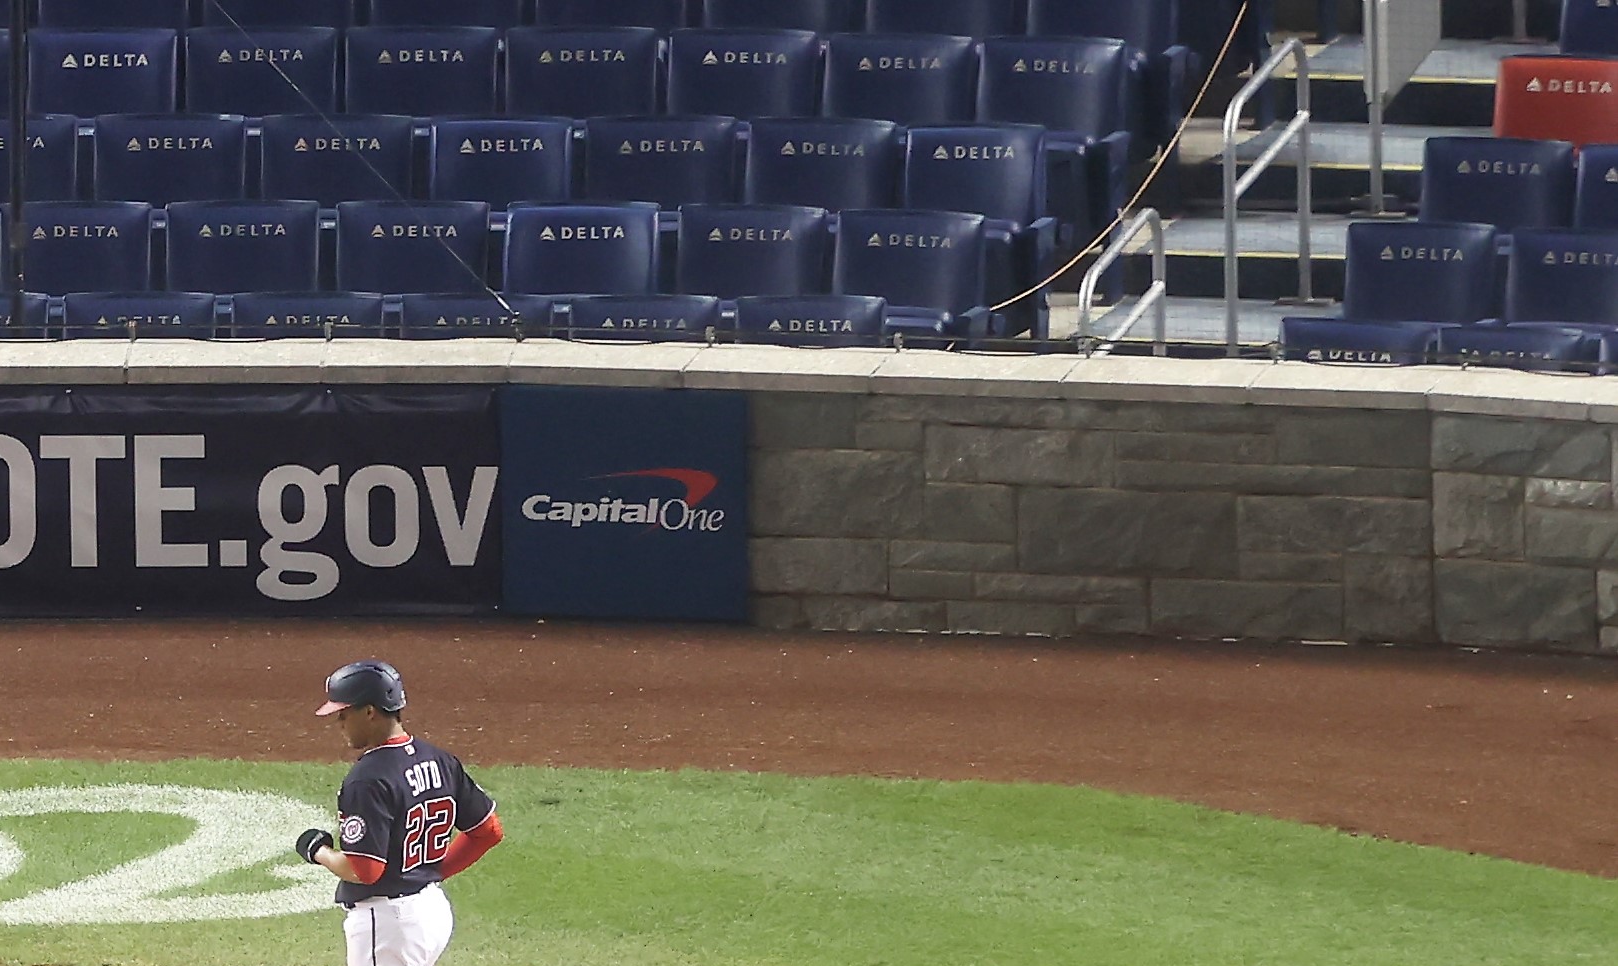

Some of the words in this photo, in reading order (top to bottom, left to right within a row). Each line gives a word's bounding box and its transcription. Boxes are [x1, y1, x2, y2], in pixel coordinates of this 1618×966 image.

[83, 54, 148, 68] DELTA
[239, 49, 303, 63] DELTA
[399, 50, 464, 64] DELTA
[560, 49, 625, 63] DELTA
[725, 51, 786, 64] DELTA
[879, 57, 941, 70] DELTA
[1034, 60, 1094, 73] DELTA
[1548, 79, 1612, 94] DELTA
[148, 138, 213, 150] DELTA
[315, 137, 381, 151] DELTA
[481, 139, 543, 152] DELTA
[640, 141, 704, 152] DELTA
[802, 142, 865, 157] DELTA
[954, 146, 1016, 161] DELTA
[1478, 161, 1541, 173] DELTA
[54, 224, 119, 239] DELTA
[220, 223, 285, 238] DELTA
[392, 225, 457, 237] DELTA
[561, 225, 625, 240] DELTA
[730, 228, 793, 242] DELTA
[889, 234, 952, 249] DELTA
[1400, 248, 1463, 261] DELTA
[1563, 252, 1618, 265] DELT
[789, 318, 853, 333] DELTA
[405, 761, 442, 796] SOTO
[402, 796, 456, 872] 22
